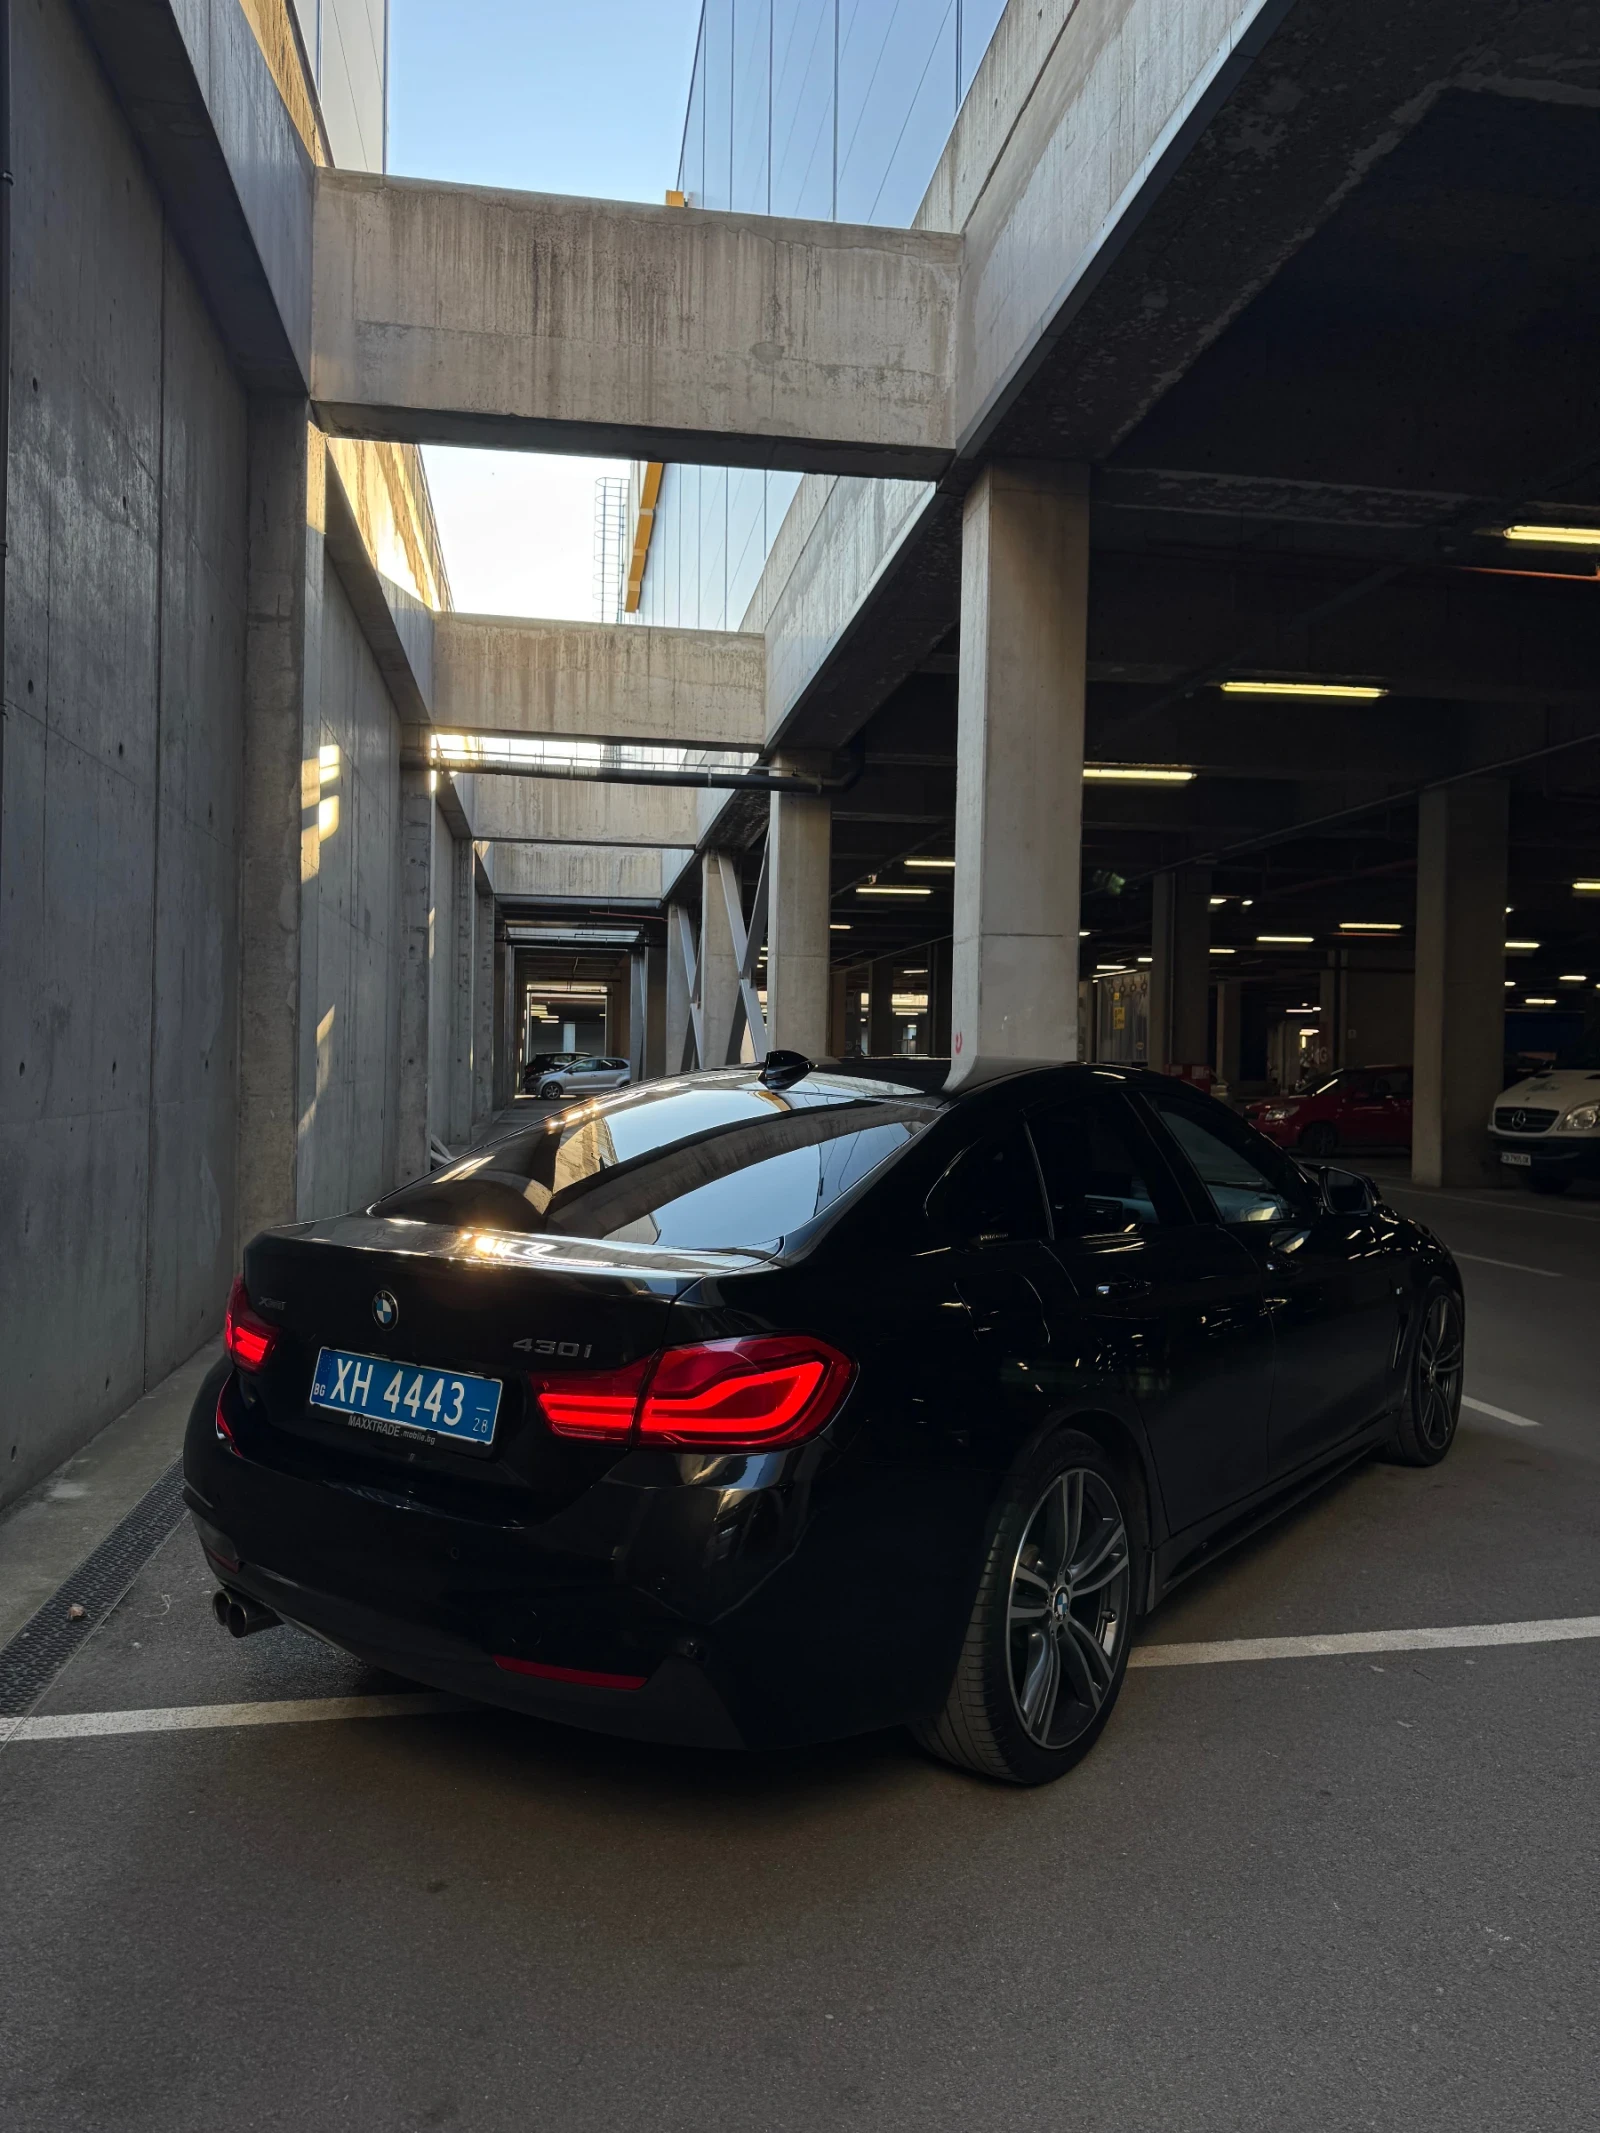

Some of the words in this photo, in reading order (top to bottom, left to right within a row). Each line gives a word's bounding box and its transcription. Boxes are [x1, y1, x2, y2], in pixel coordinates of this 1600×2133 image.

[513, 1338, 592, 1359] 430i
[313, 1383, 326, 1396] BG
[329, 1358, 374, 1407] XH
[383, 1369, 465, 1426] 4443
[472, 1417, 489, 1433] 28
